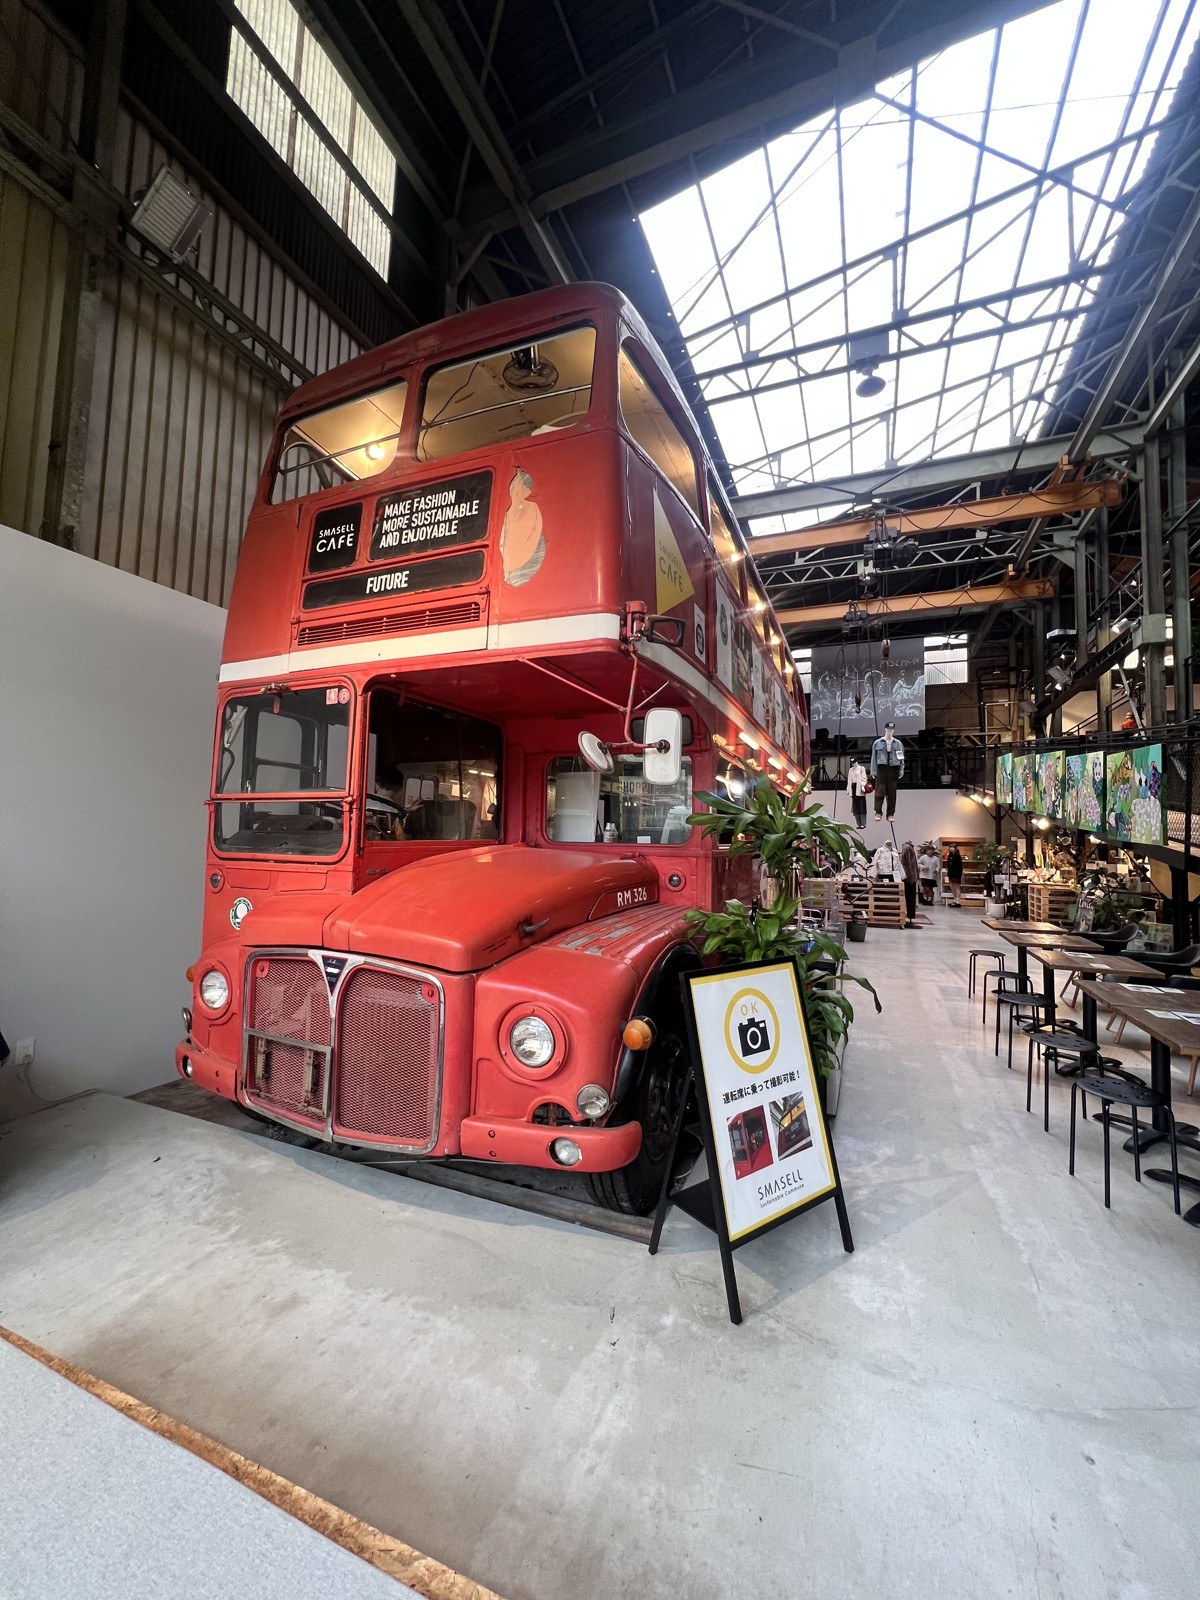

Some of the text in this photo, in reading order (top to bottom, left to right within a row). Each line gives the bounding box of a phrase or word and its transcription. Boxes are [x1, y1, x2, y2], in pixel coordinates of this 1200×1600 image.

[382, 500, 479, 533] MORE SUSTAINABLE
[384, 490, 456, 518] MAKE FASHION
[316, 533, 354, 553] CAFE
[319, 523, 354, 538] SMASELL
[379, 520, 458, 548] AND ENJOYABLE
[366, 570, 410, 594] FUTURE
[659, 557, 683, 593] CAFE
[617, 886, 647, 907] RM 326
[757, 1169, 803, 1201] SMASELL
